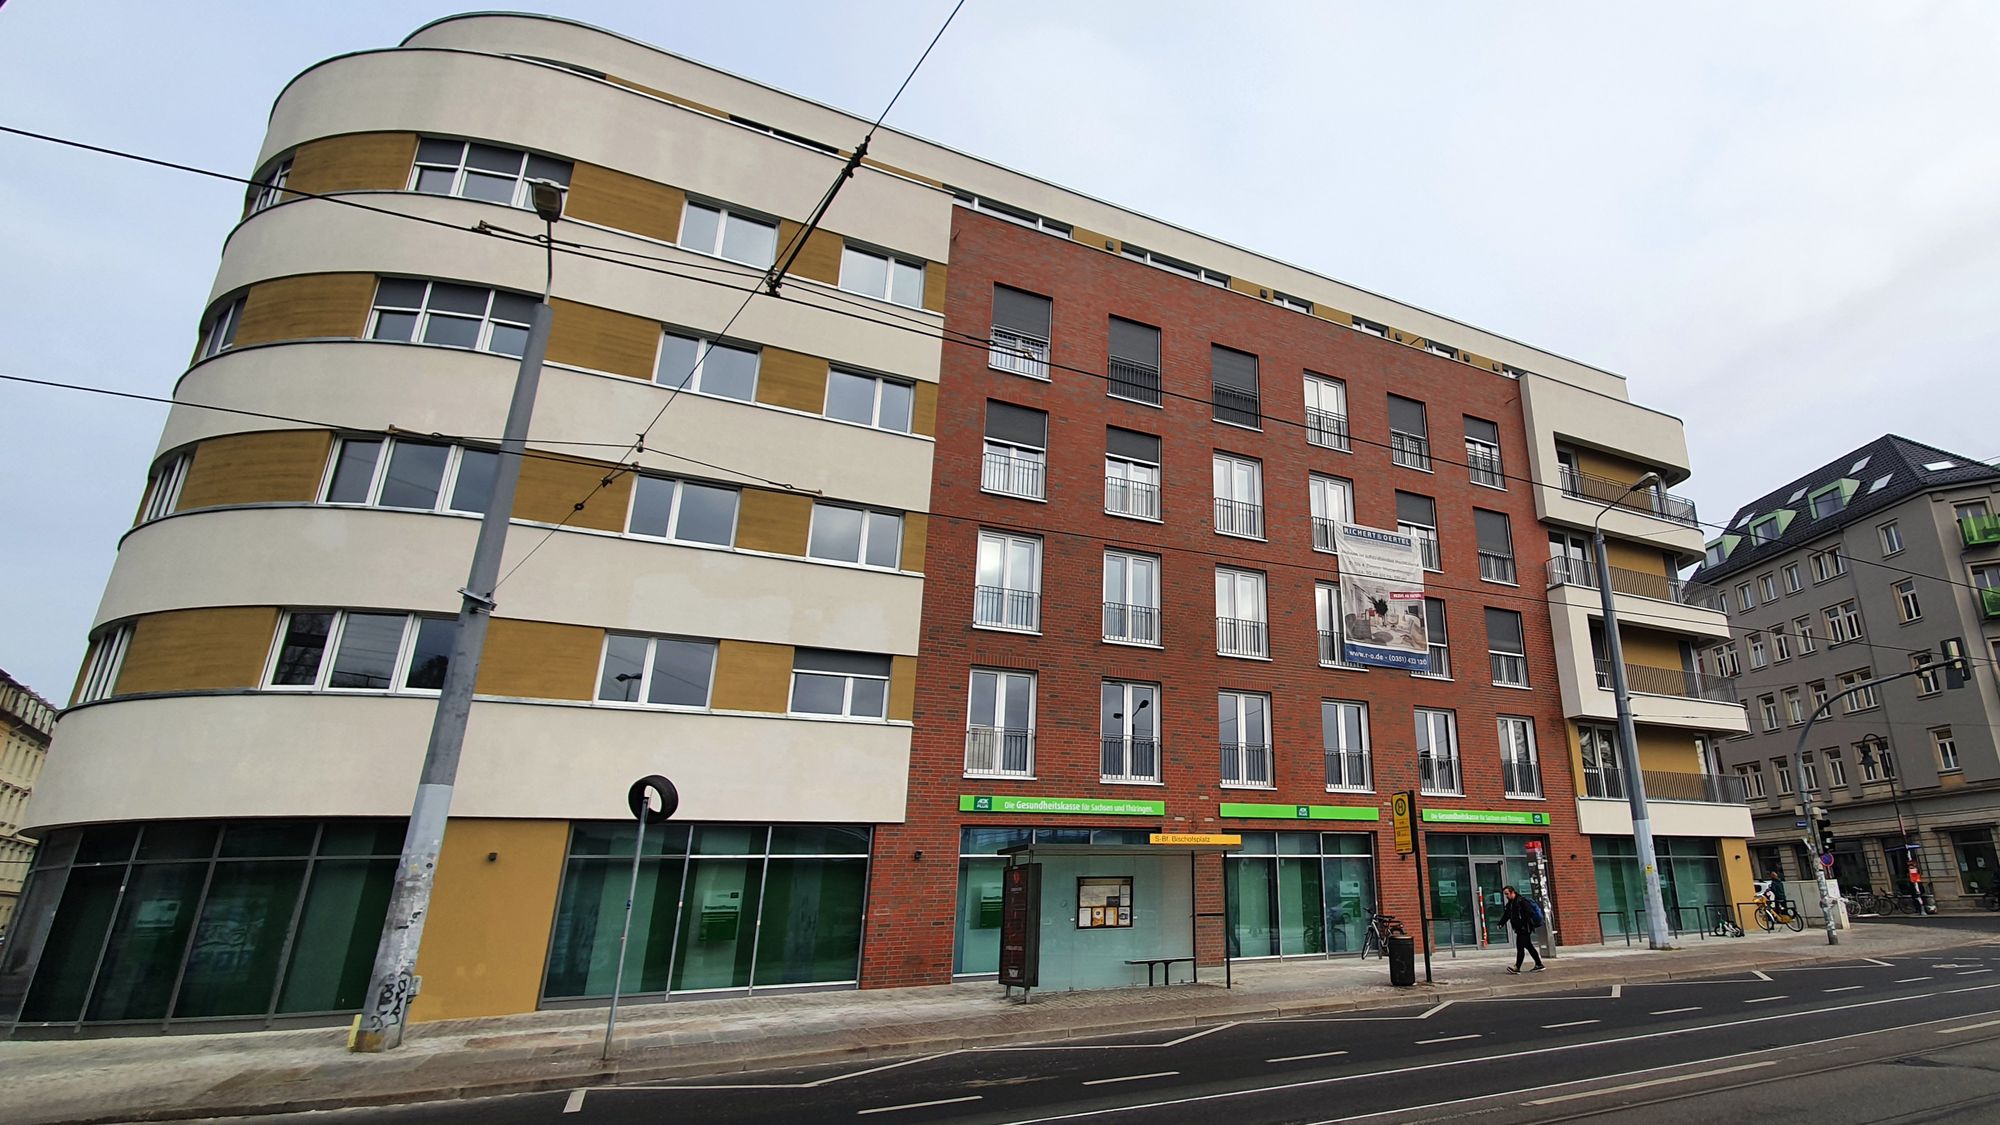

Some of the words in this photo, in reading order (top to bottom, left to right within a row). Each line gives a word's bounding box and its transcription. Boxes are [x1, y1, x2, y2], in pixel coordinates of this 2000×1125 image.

[1344, 527, 1376, 538] RICHERT
[1383, 534, 1410, 545] OERTEL
[1349, 650, 1383, 660] www.r-o.de
[1004, 801, 1015, 809] Die
[1016, 800, 1080, 811] Gesundheitskasse
[1081, 802, 1090, 811] für
[1091, 804, 1113, 812] Sachsen
[1114, 804, 1125, 812] und
